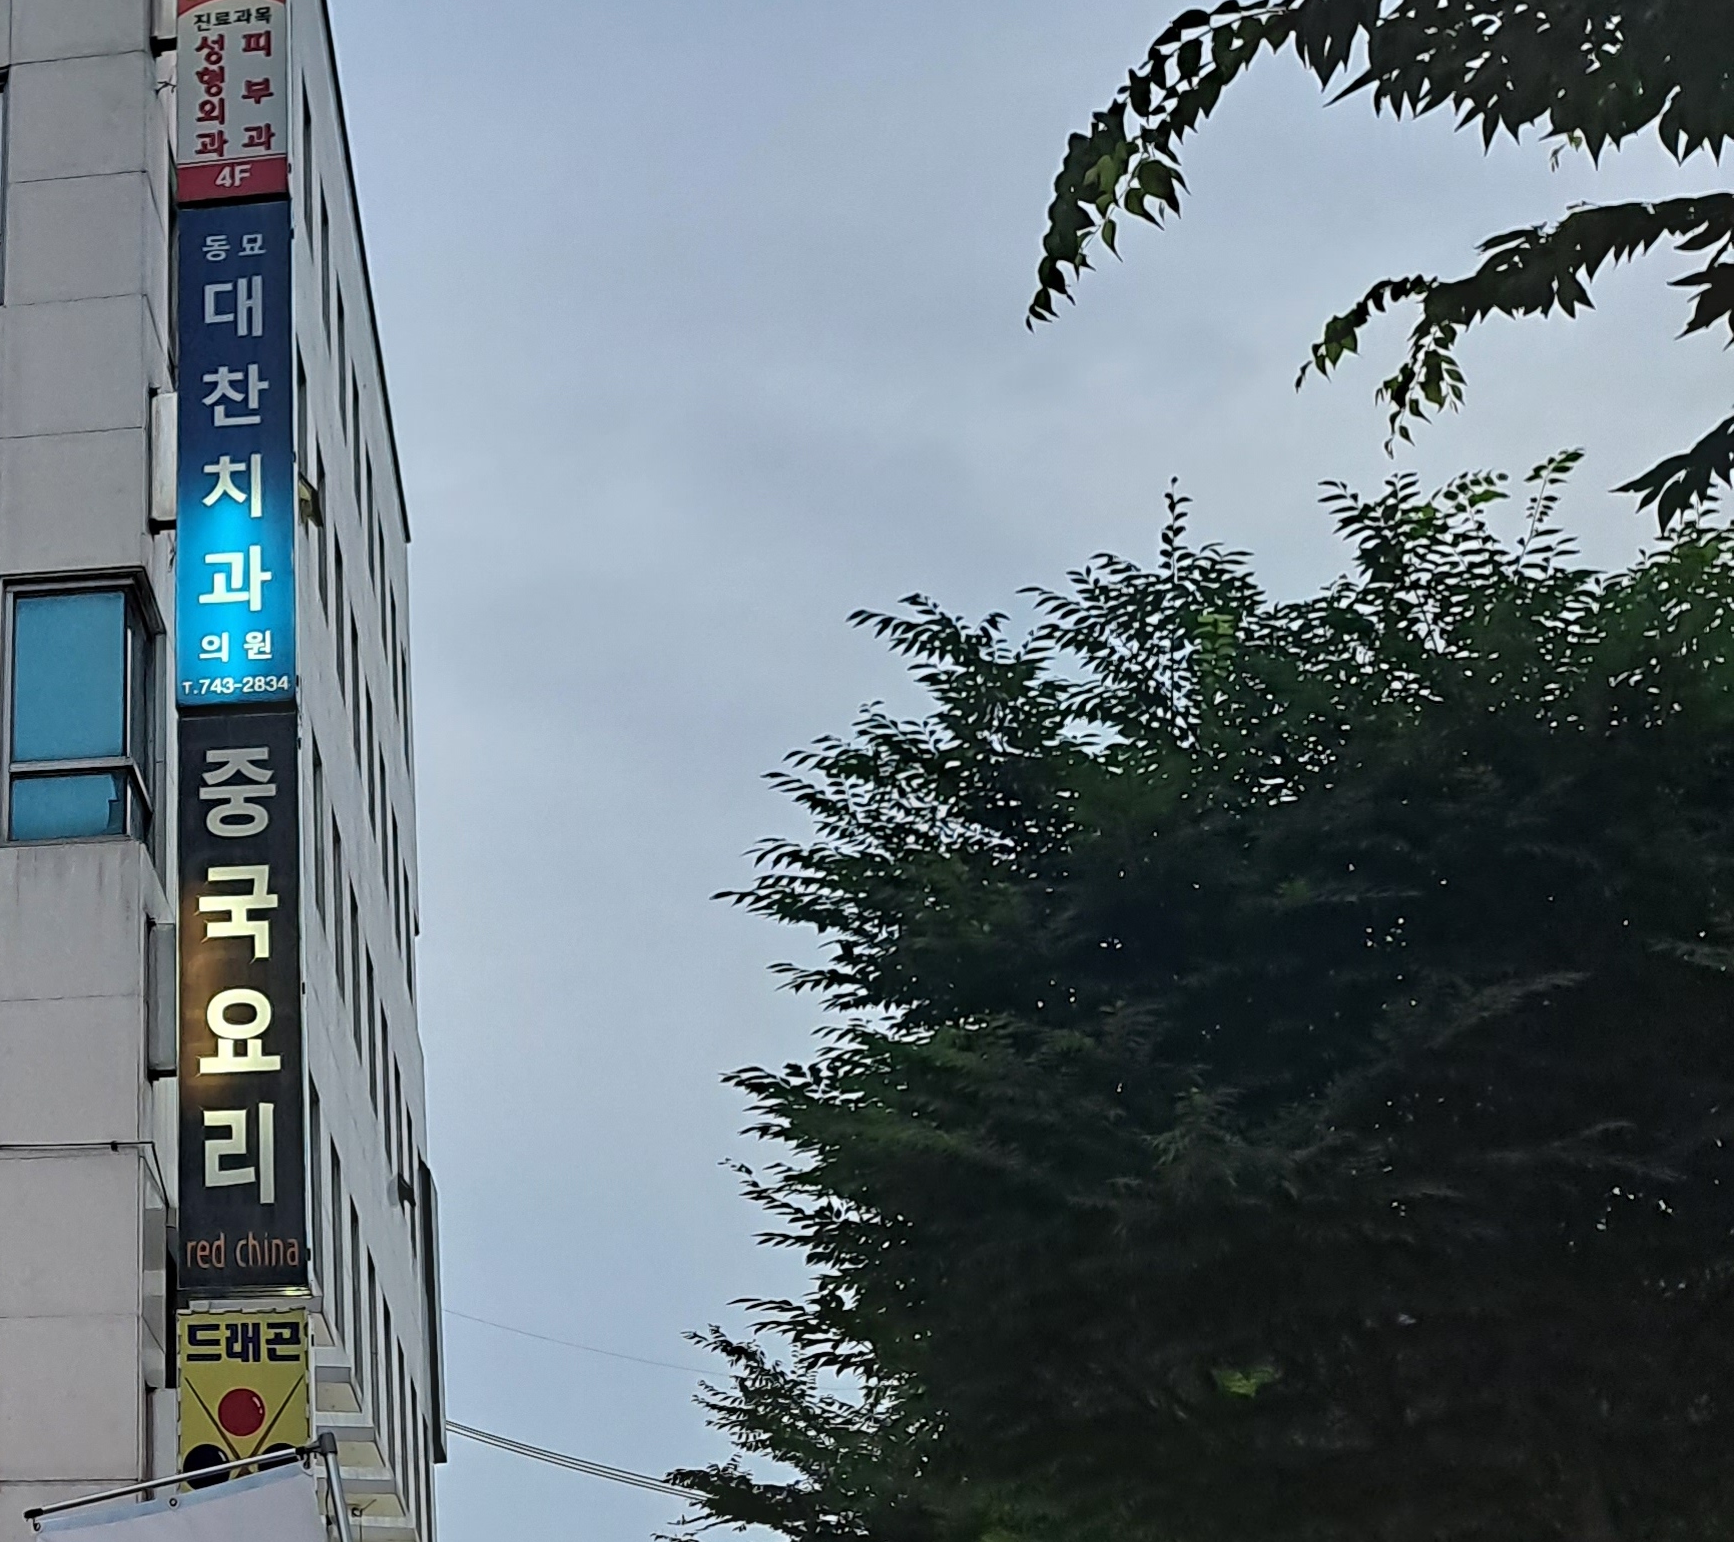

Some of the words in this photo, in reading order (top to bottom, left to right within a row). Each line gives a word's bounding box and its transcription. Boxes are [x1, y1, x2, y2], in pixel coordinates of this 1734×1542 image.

[193, 7, 272, 32] 진료과목
[195, 33, 228, 157] 성형외과
[242, 30, 275, 151] 피부과
[215, 164, 252, 187] 4F
[202, 233, 266, 262] 동묘
[198, 274, 272, 613] 대찬치과
[199, 630, 273, 663] 의원
[182, 675, 289, 696] T.743-2834
[198, 747, 281, 1204] 중국요리
[186, 1232, 225, 1268] red
[236, 1232, 299, 1267] china
[186, 1321, 302, 1363] 드래곤
